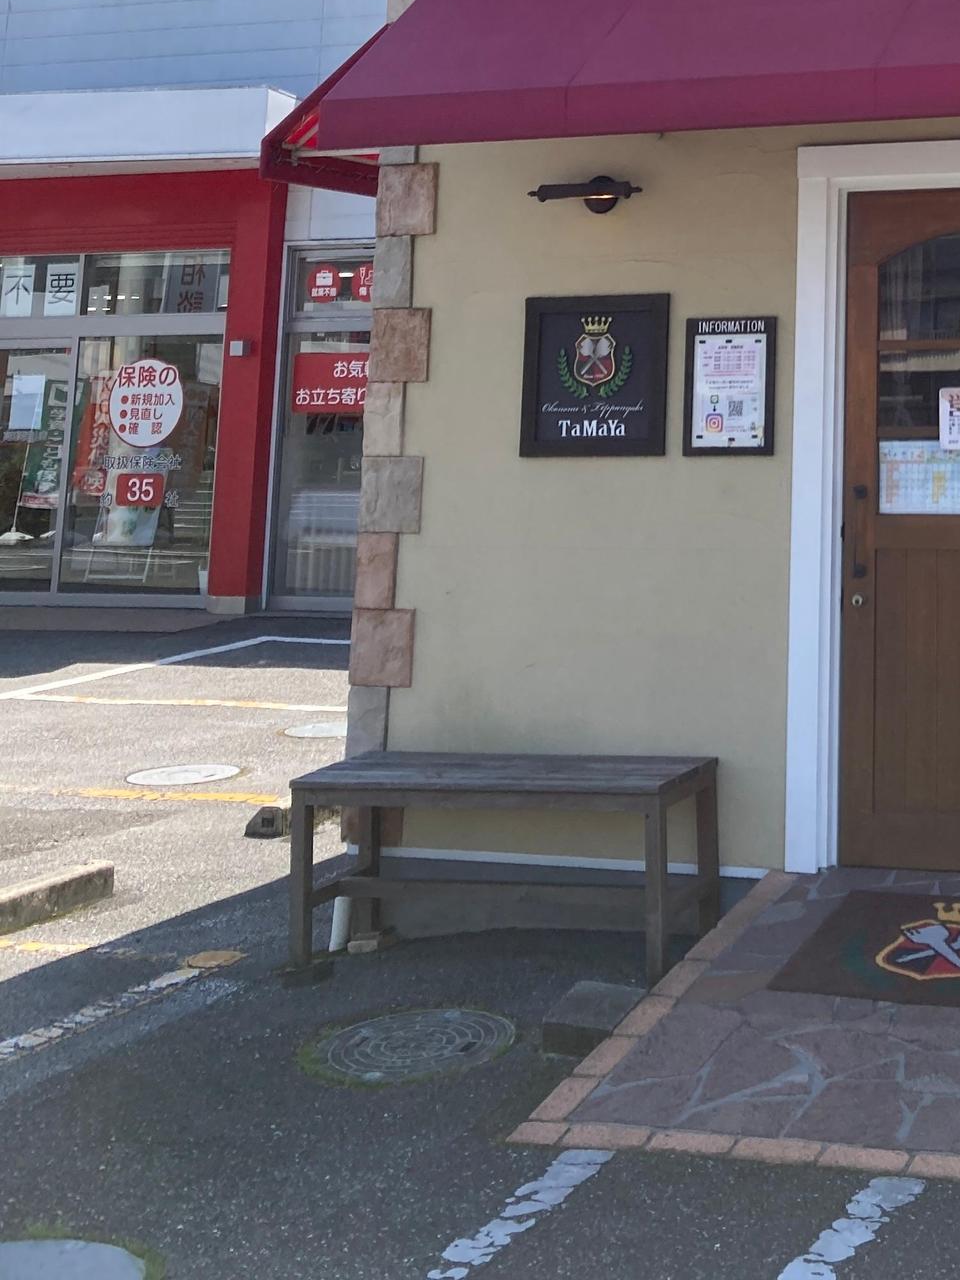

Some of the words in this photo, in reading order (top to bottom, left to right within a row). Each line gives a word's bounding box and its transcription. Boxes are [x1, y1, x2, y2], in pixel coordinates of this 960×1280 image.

[698, 320, 765, 333] INFORMATION
[117, 365, 179, 388] 保険の
[333, 360, 369, 378] お気
[130, 393, 176, 406] 新規加入
[129, 408, 163, 421] 見直し
[558, 418, 626, 437] TaMaYa
[104, 455, 183, 471] 取扱保険会社
[127, 478, 154, 502] 35
